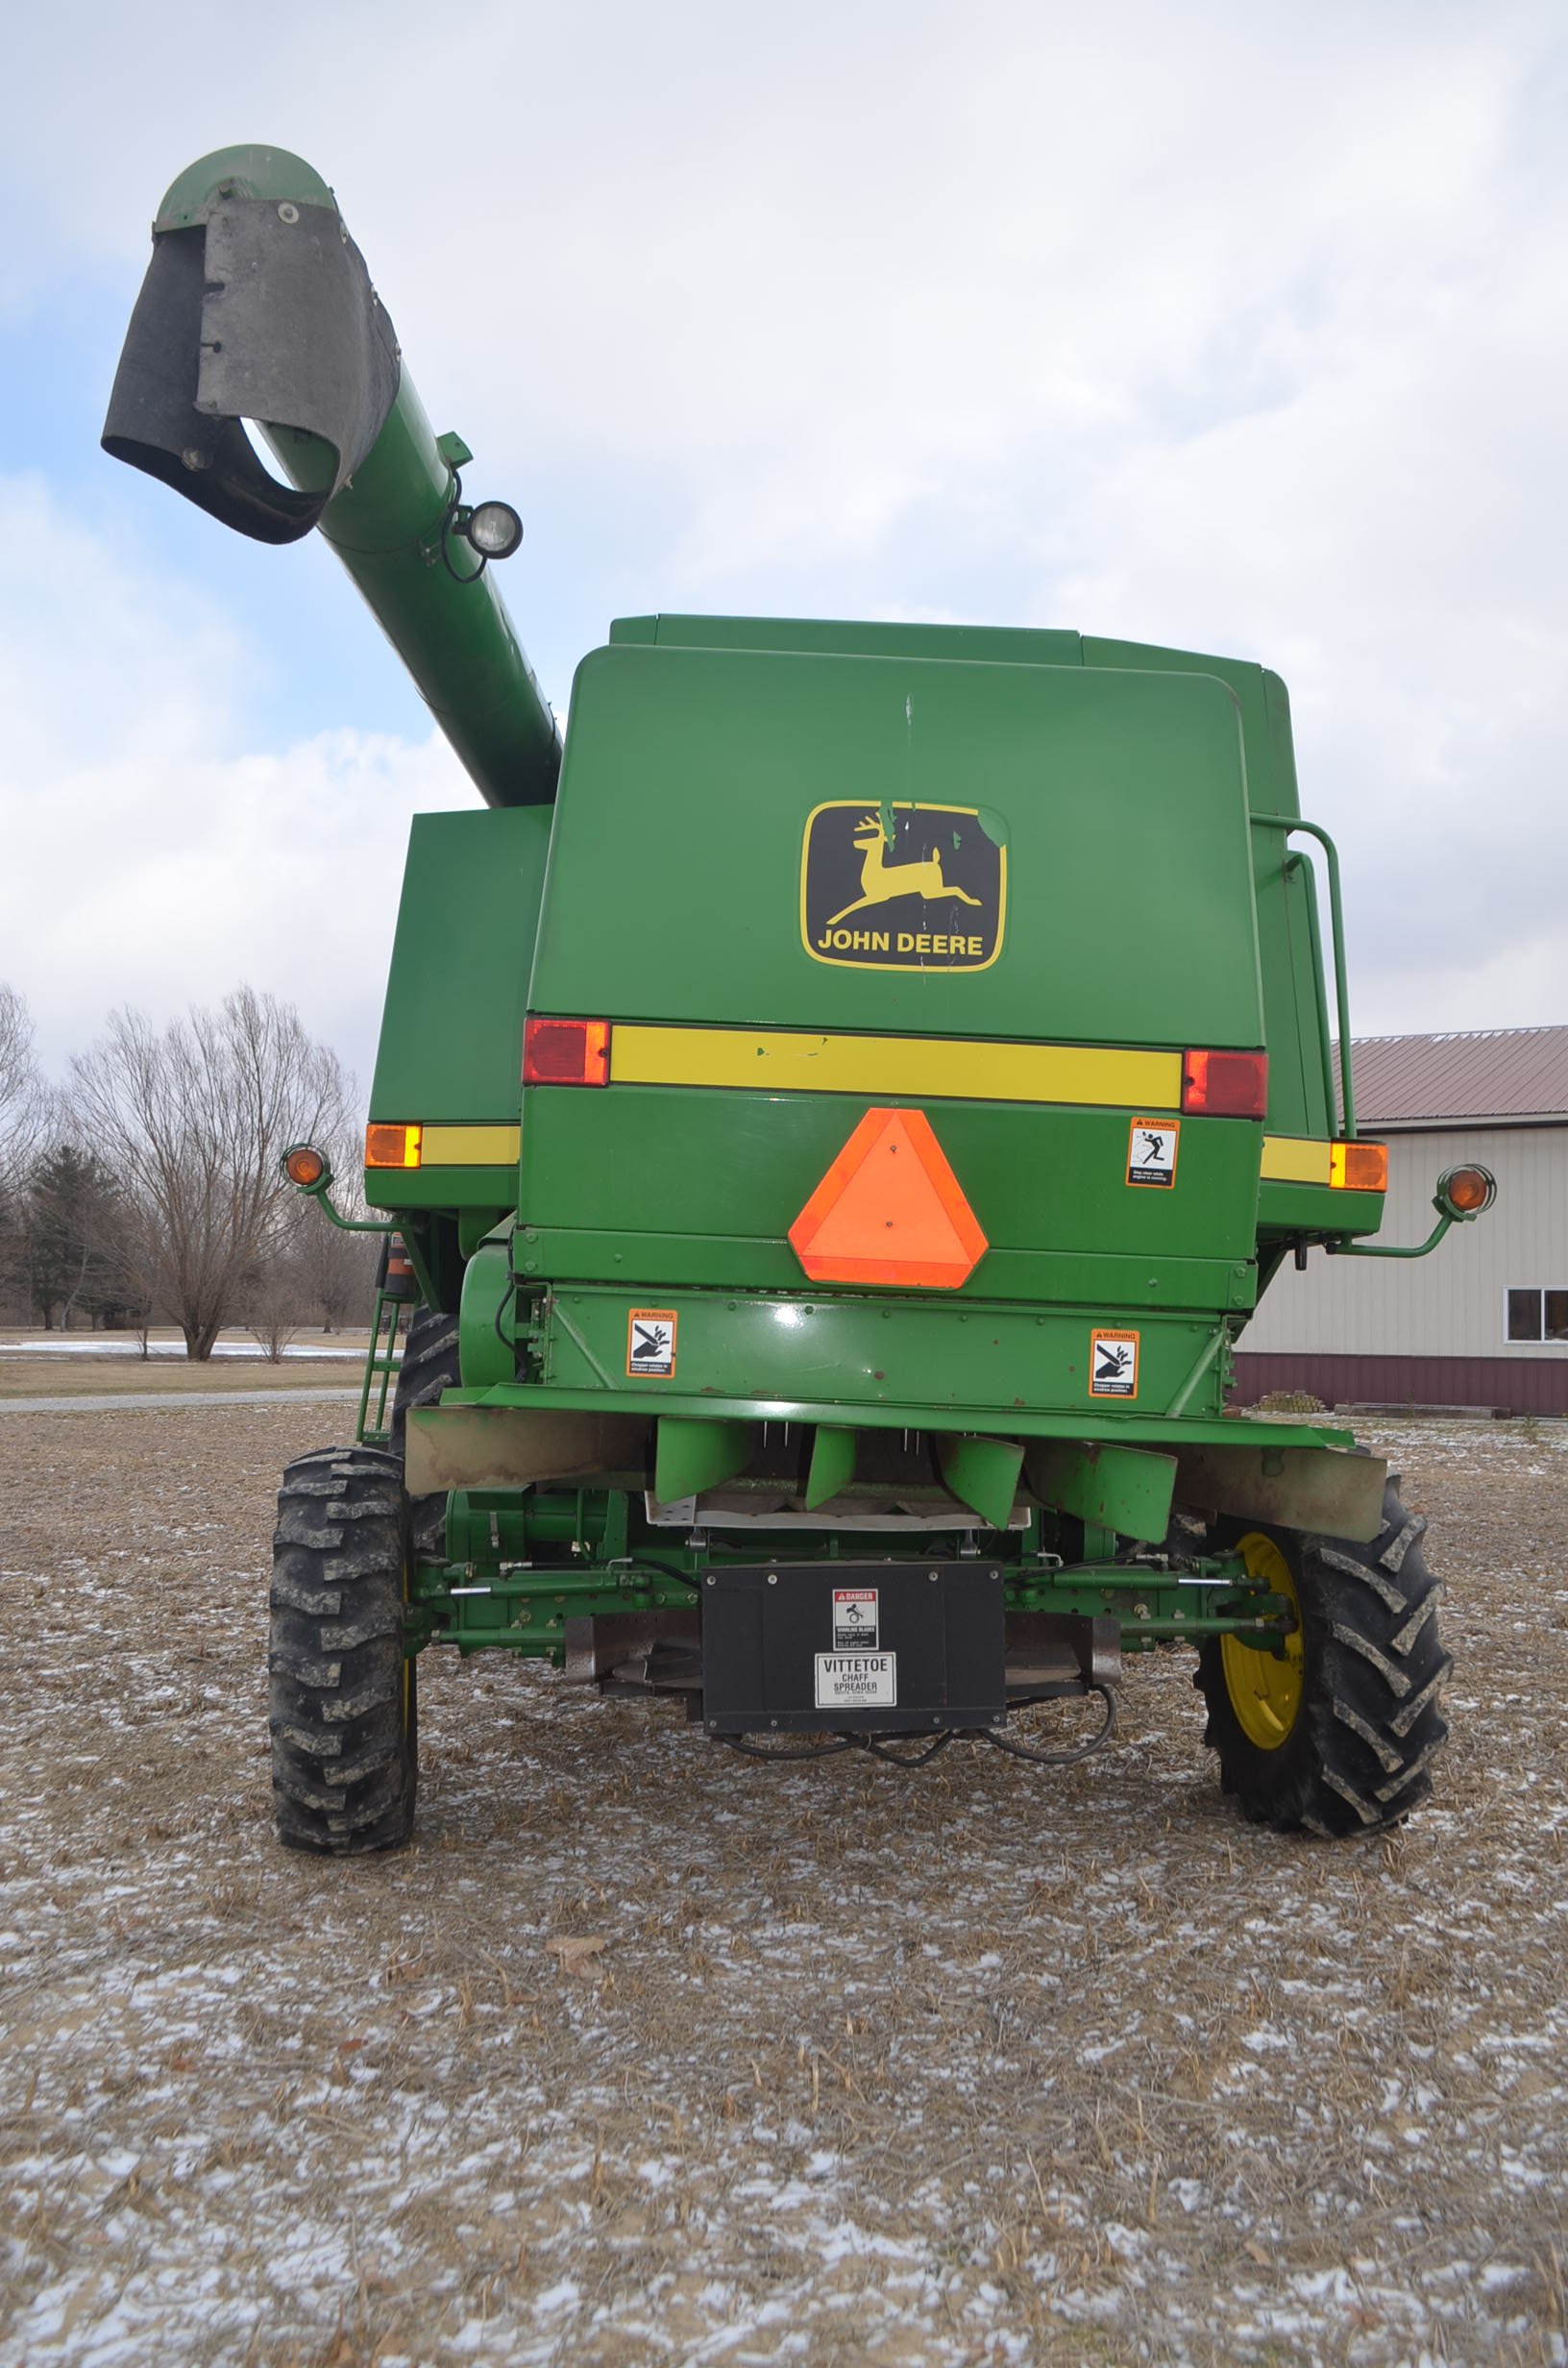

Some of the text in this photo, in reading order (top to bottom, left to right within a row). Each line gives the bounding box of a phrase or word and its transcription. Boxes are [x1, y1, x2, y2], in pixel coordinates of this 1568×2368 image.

[818, 929, 984, 956] JOHN DEERE
[1144, 1120, 1175, 1128] WARNING
[845, 1592, 873, 1601] DANGER
[823, 1658, 888, 1673] VITTETOE
[842, 1673, 870, 1682] CHAFF
[833, 1682, 877, 1691] SPREADER
